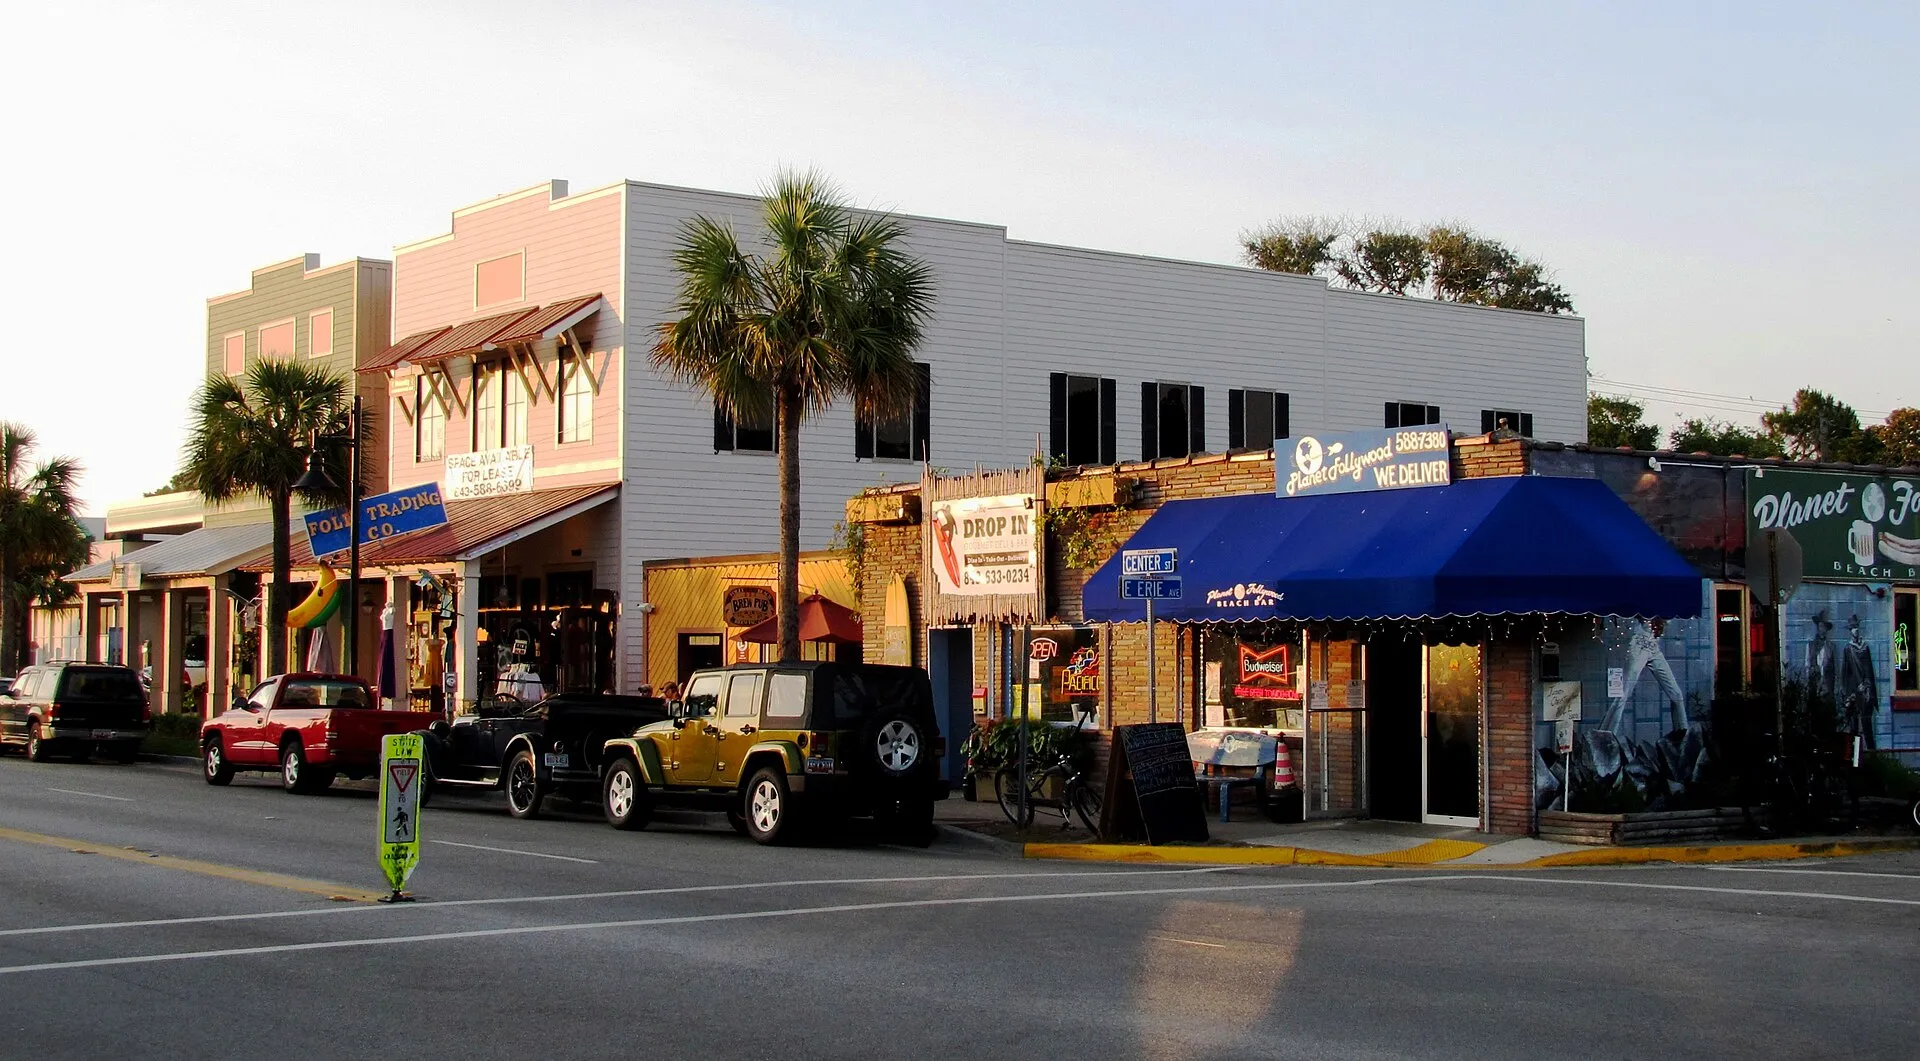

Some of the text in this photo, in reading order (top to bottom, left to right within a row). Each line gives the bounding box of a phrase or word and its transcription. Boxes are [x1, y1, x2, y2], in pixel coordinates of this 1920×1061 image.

[447, 456, 477, 469] SPACE
[1286, 438, 1393, 496] Planet Follywood
[462, 465, 514, 483] FOR LEASE
[1373, 460, 1449, 488] WE DELIVER
[307, 491, 442, 537] FOLL TRADING
[1753, 481, 1856, 530] Planet
[963, 514, 1029, 539] DROP IN
[1125, 554, 1171, 572] CENTER ST
[1833, 561, 1892, 577] BEACH
[1124, 581, 1180, 598] E ERIE AVE
[1206, 587, 1234, 604] Planet
[732, 597, 769, 612] BREW PUB
[1216, 598, 1275, 608] BEACH BAR
[1243, 658, 1284, 673] Budweiser
[392, 738, 418, 747] STATE
[395, 748, 412, 756] LAW
